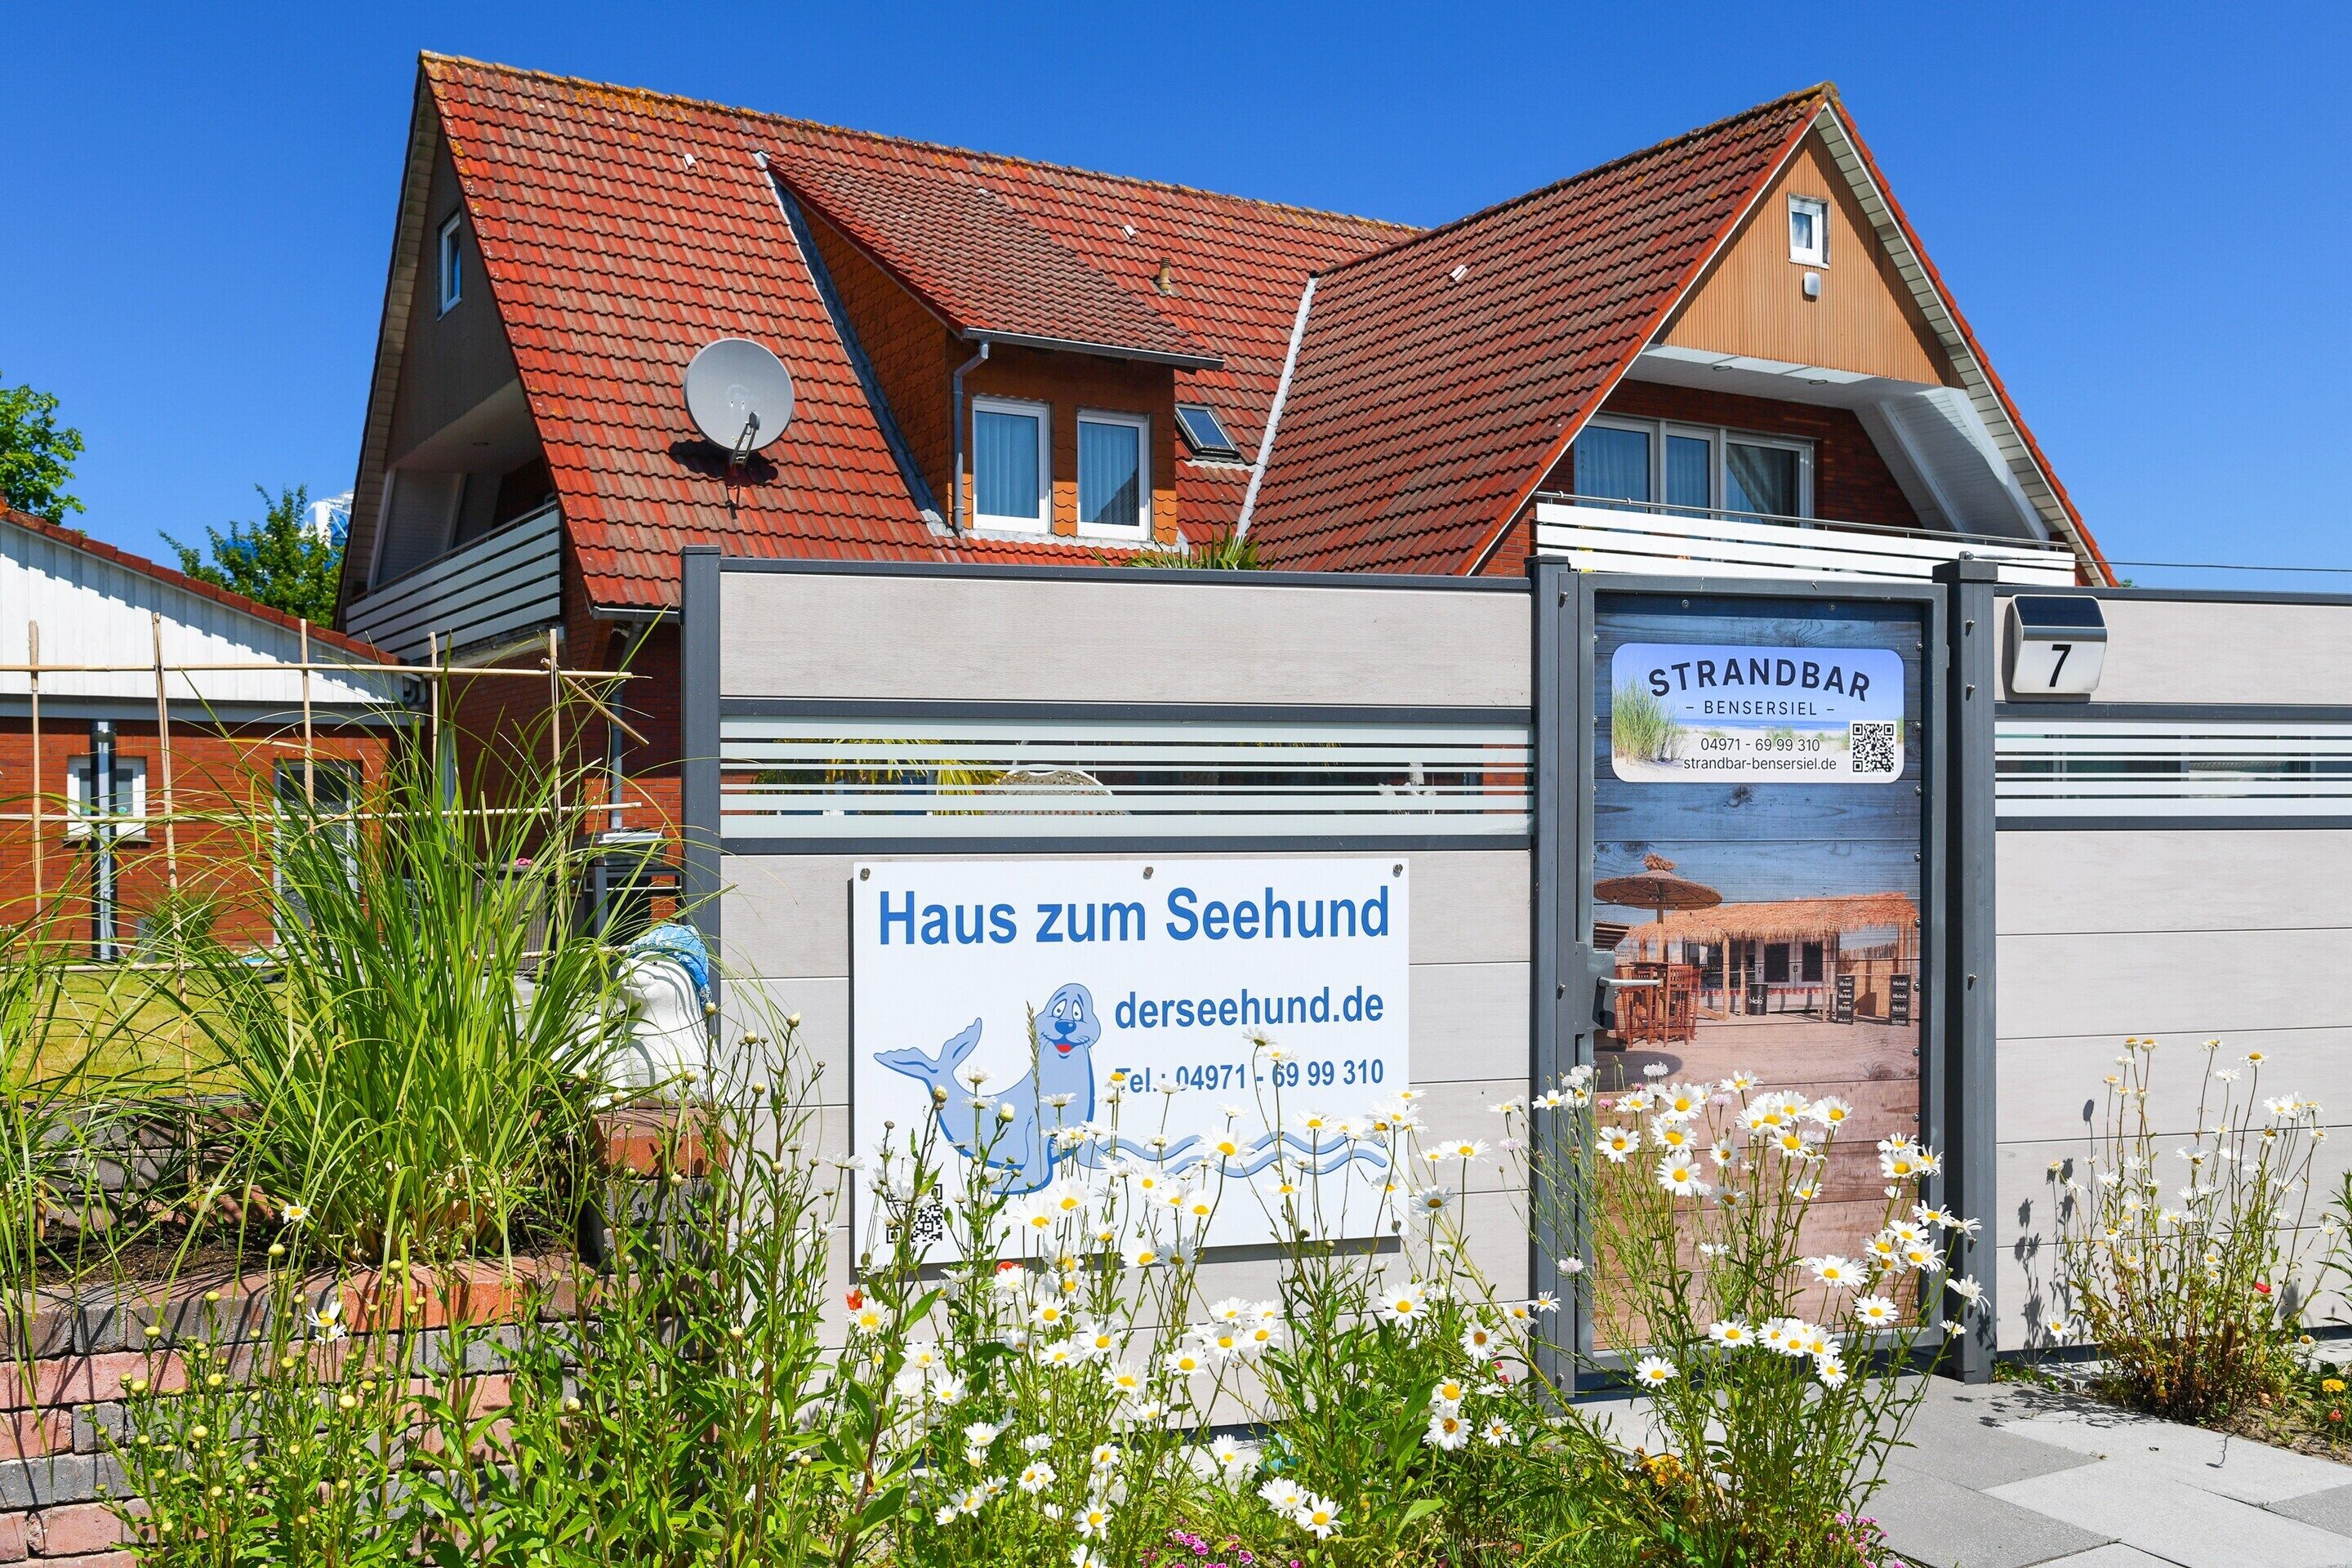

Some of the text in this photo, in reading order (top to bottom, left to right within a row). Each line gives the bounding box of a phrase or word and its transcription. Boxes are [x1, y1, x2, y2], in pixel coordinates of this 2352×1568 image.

[1649, 657, 1870, 702] STRANDBAR
[2048, 644, 2072, 688] 7
[1704, 700, 1817, 716] BENSERSIEL
[1683, 756, 1837, 770] strandbar-bensersiel.de
[1700, 737, 1740, 751] 04971
[1755, 737, 1772, 751] 69
[1775, 738, 1793, 751] 99
[1797, 738, 1820, 752] 310
[880, 885, 1389, 946] Haus zum Seehund
[1115, 986, 1383, 1029] derseehund.de
[1175, 1064, 1245, 1091] 04971
[1272, 1061, 1300, 1089] 69
[1307, 1060, 1335, 1086] 99
[1343, 1058, 1384, 1085] 310
